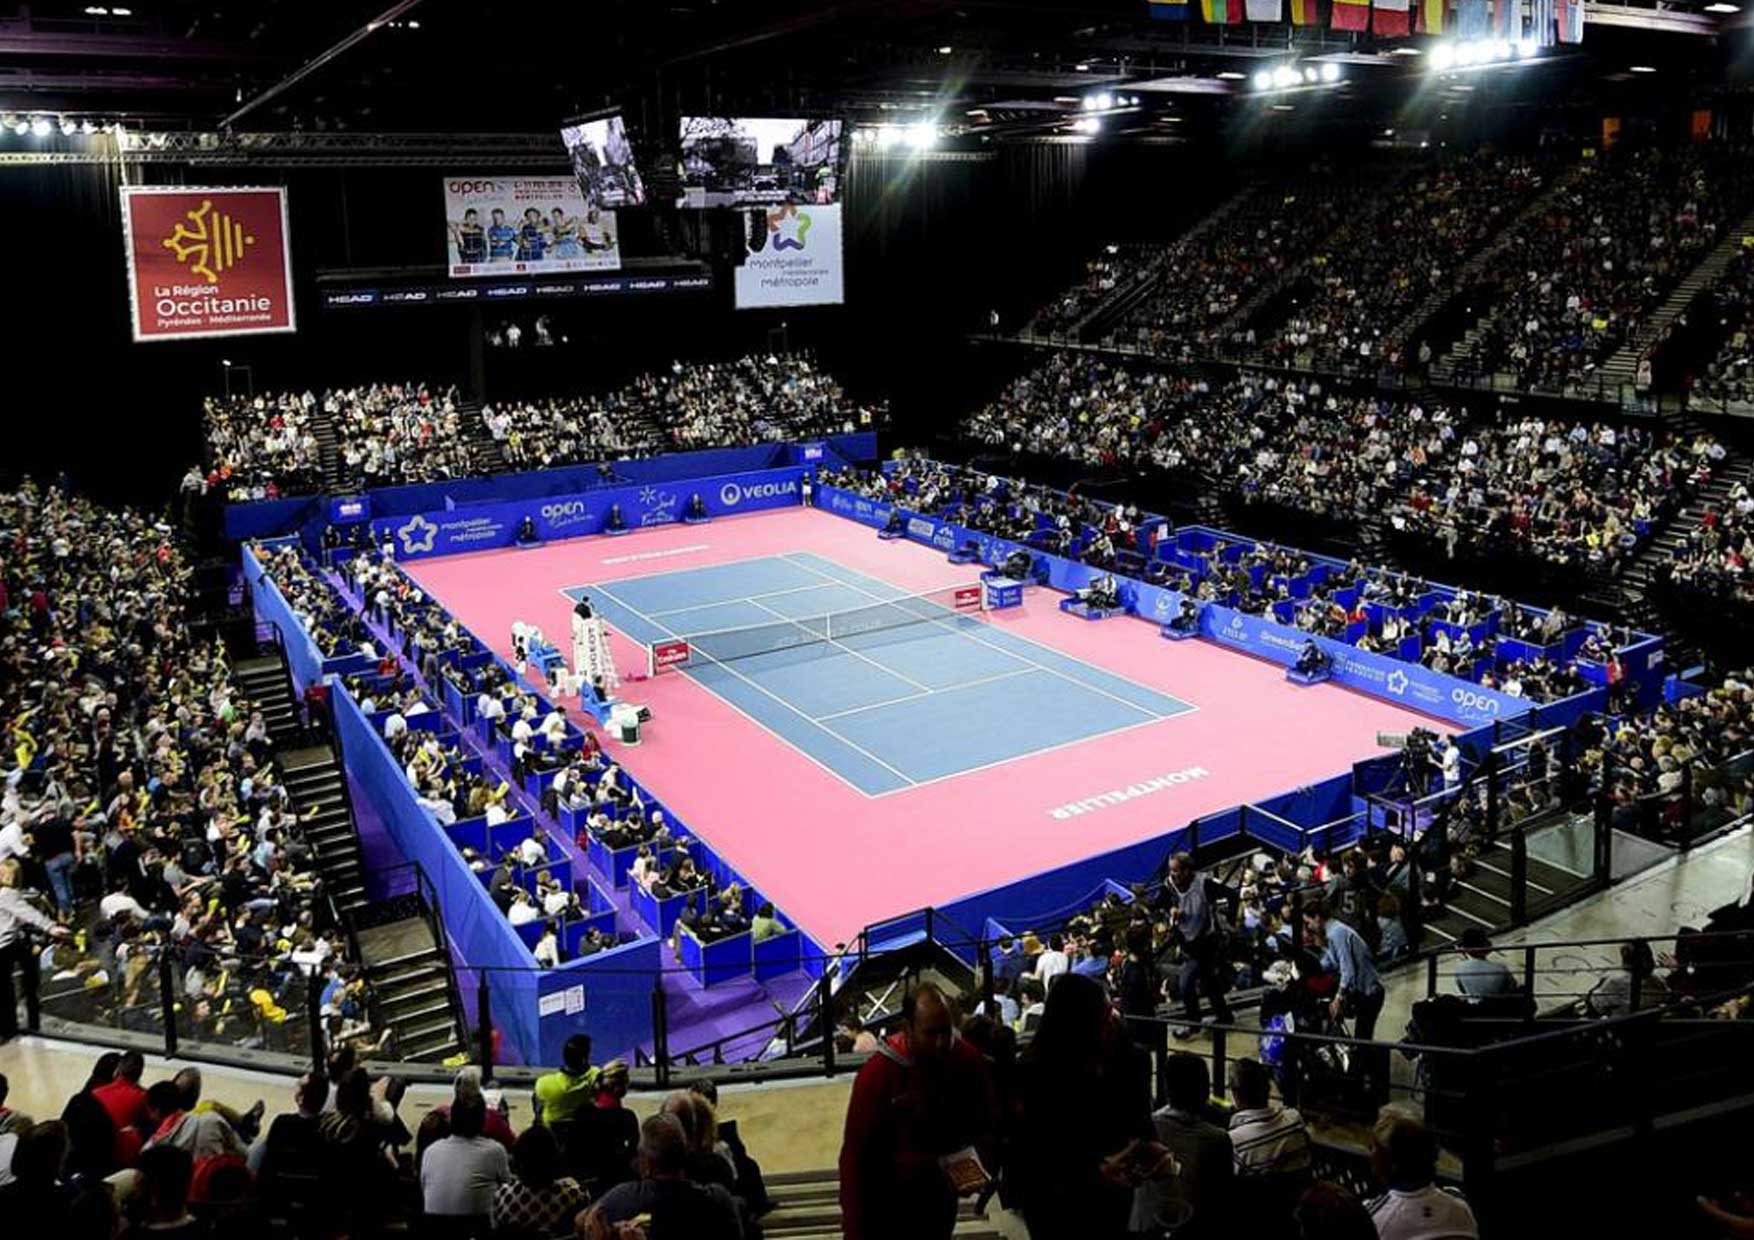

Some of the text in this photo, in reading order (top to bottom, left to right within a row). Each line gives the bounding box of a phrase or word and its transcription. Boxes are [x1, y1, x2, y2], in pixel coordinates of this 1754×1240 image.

[154, 285, 219, 298] La Région
[329, 279, 709, 304] HEAD HEAD HEAD HEAD HEAD HEAD HEAD HEAD
[156, 295, 271, 316] Occitanie
[742, 480, 797, 499] VEOLIA
[1051, 766, 1210, 820] MONTPELLIER
[1342, 890, 1356, 914] 5
